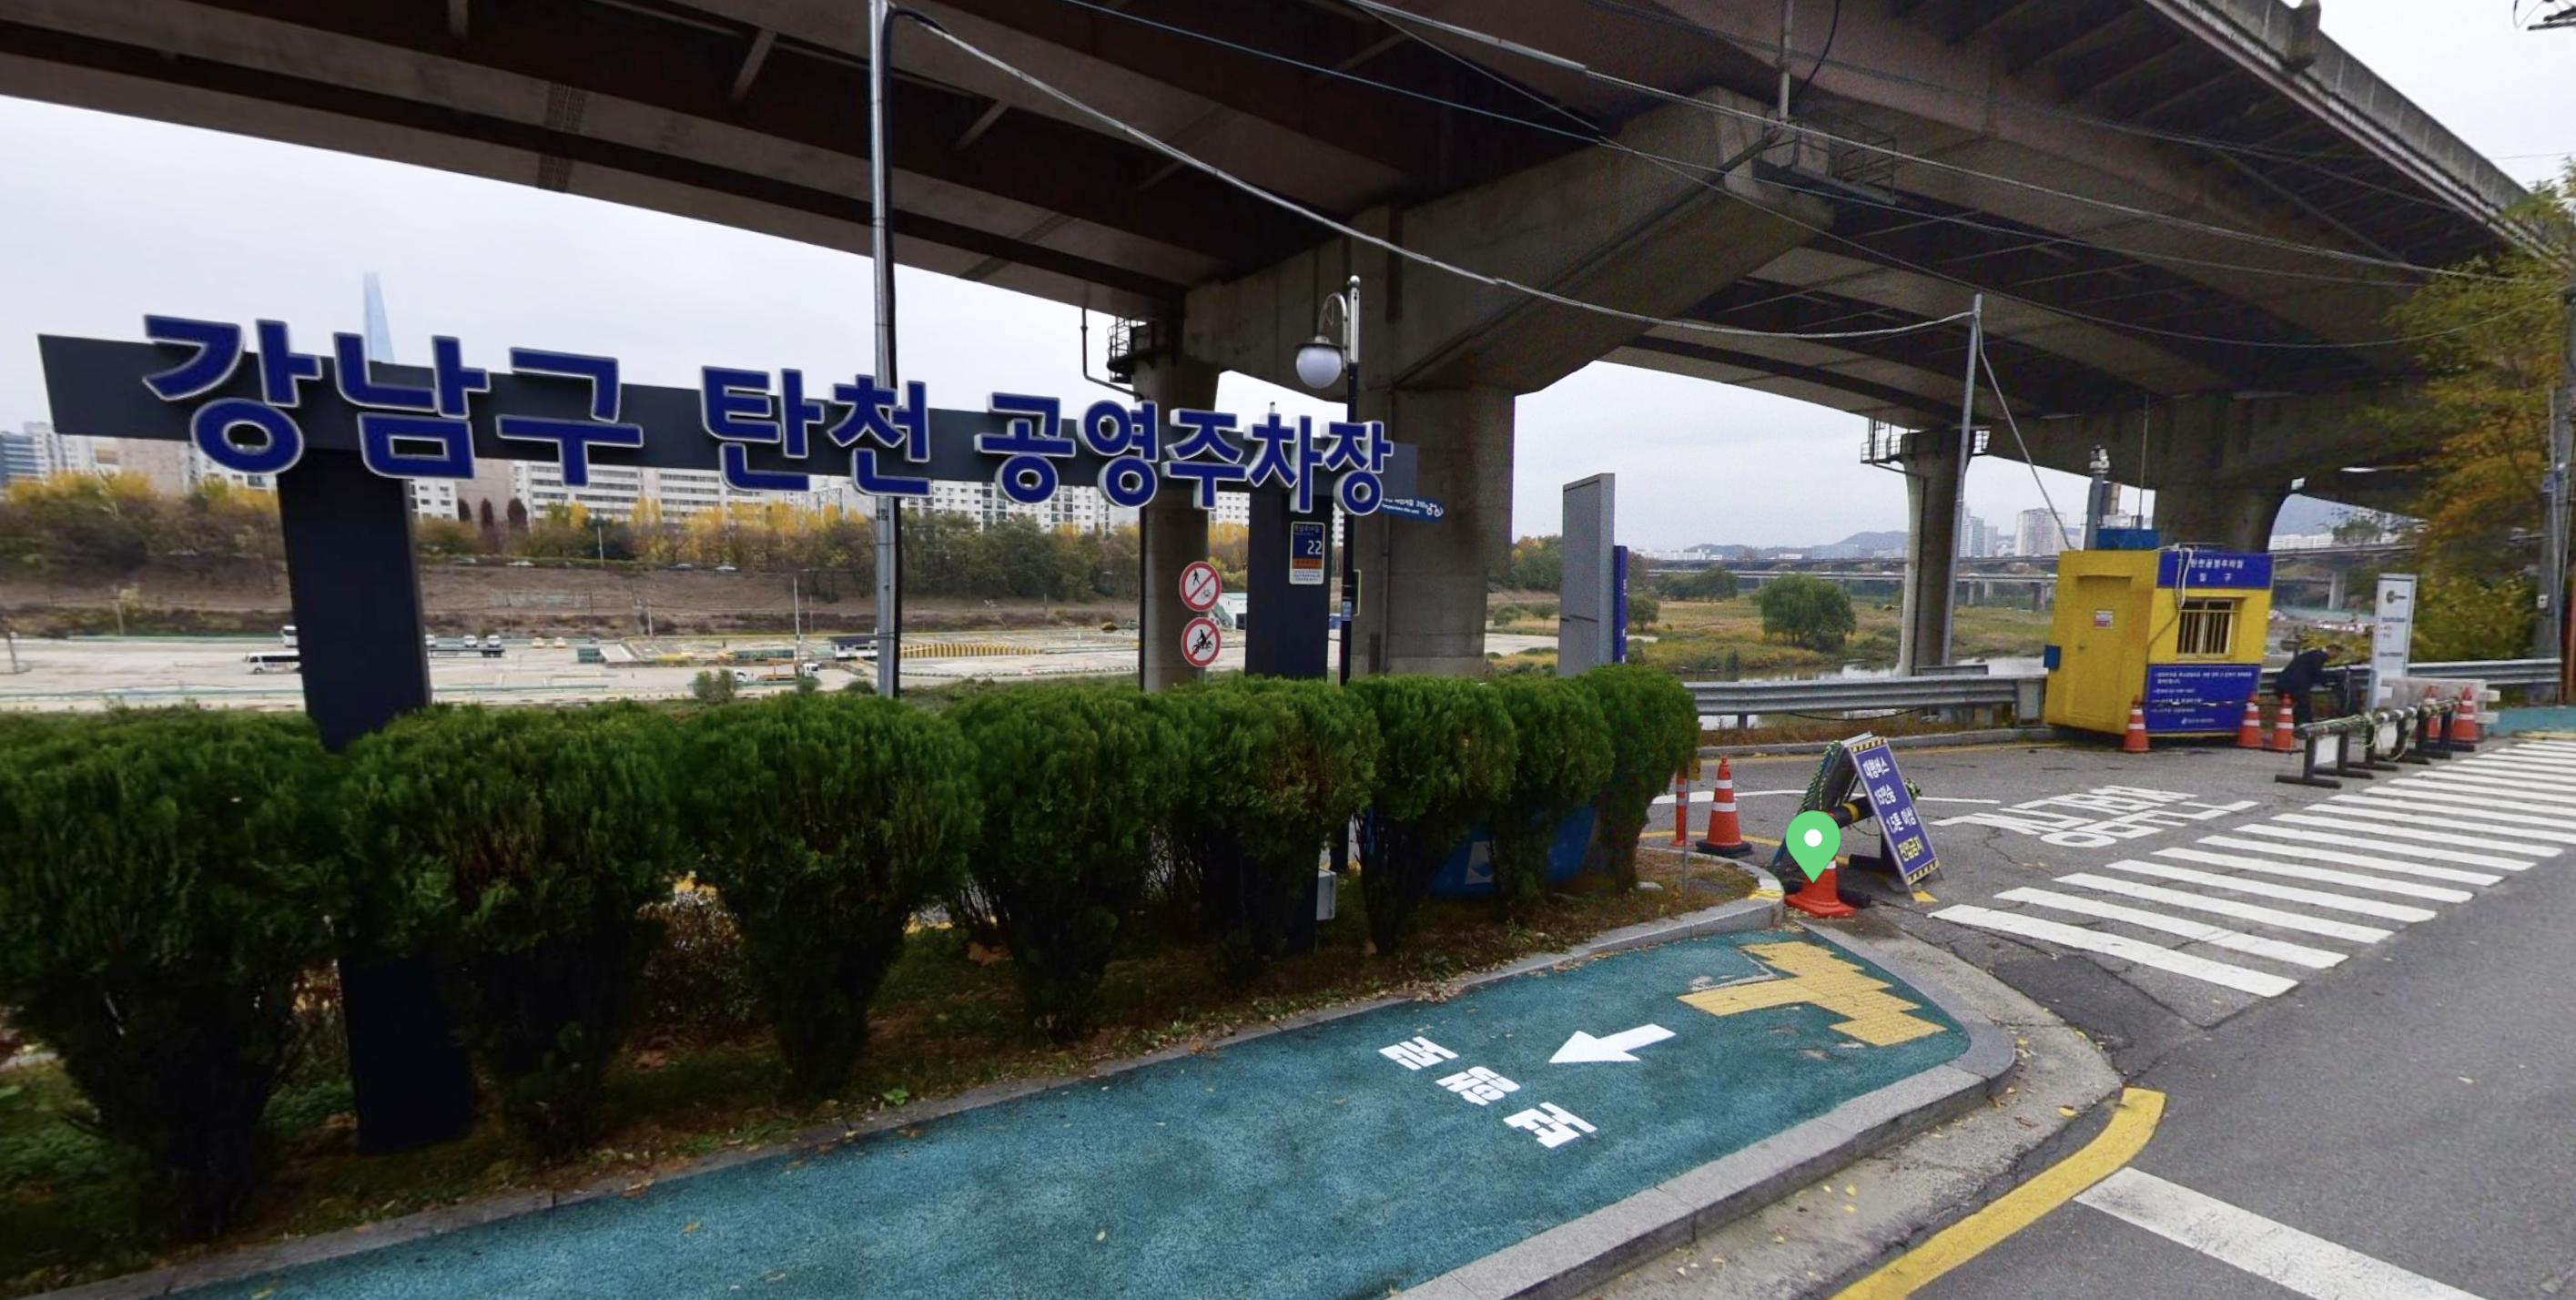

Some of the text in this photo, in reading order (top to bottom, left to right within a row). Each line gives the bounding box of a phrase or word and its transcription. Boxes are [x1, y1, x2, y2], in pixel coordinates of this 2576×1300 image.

[142, 314, 1394, 516] 강남구 탄천 공영주차장
[1307, 540, 1322, 555] 22
[1861, 757, 1891, 780] 대형버스
[1874, 784, 1897, 806] 15인승
[1900, 806, 1917, 828] 이상
[1897, 834, 1925, 862] 진입금지
[1378, 1036, 1597, 1149] 보행로
